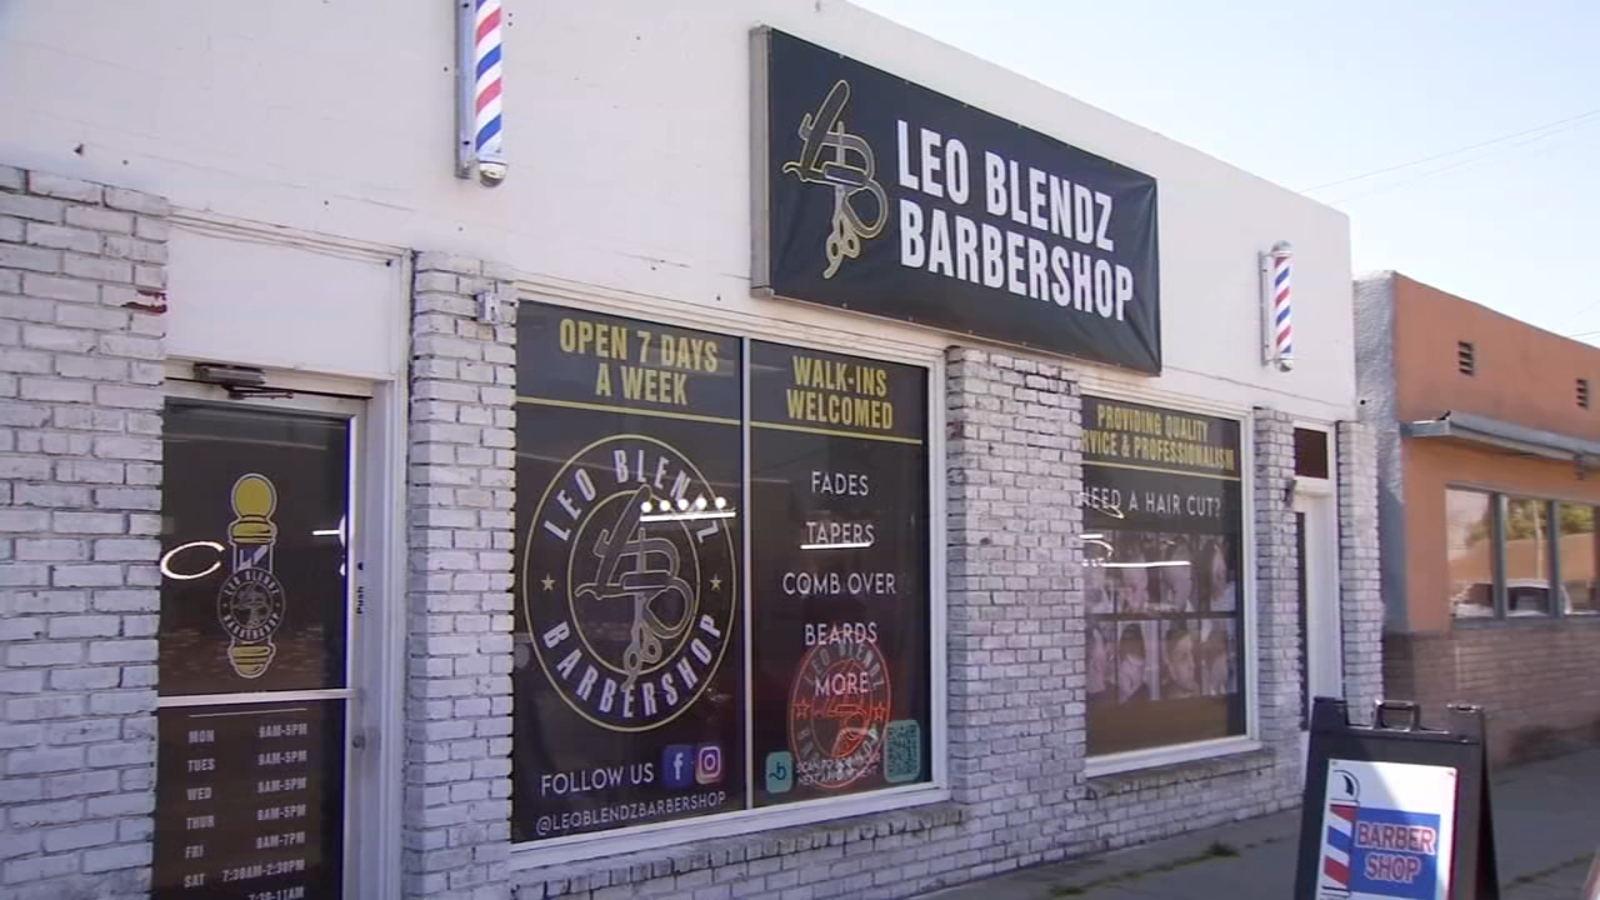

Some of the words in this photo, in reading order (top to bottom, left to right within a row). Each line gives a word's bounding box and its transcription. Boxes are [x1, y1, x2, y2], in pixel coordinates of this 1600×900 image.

[897, 119, 969, 205] LEO
[985, 151, 1114, 252] BLENDZ
[900, 199, 1133, 321] BARBERSHOP
[559, 318, 628, 361] OPEN
[637, 331, 652, 362] 7
[661, 334, 719, 372] DAYS
[595, 364, 611, 397] A
[621, 370, 688, 406] WEEK
[793, 355, 888, 398] WALK-INS
[786, 389, 893, 430] WELCOMED
[1097, 404, 1162, 435] PROVIDING
[1165, 415, 1208, 442] QUALITY
[1080, 429, 1117, 456] RVICE
[1121, 434, 1130, 457] &
[1134, 436, 1235, 471] PROFESSIONALISM
[544, 468, 597, 541] LEO
[613, 450, 719, 543] BLENZ
[811, 471, 869, 496] FADES
[1129, 490, 1139, 511] A
[1145, 492, 1180, 515] HAIR
[1186, 495, 1221, 517] CUT?
[806, 521, 875, 545] TAPERS
[783, 572, 840, 596] COMB
[848, 571, 896, 595] OVER
[805, 622, 877, 646] BEARDS
[543, 613, 720, 718] BARBERSHOP
[814, 672, 869, 696] MORE
[188, 730, 214, 743] MON
[187, 758, 215, 772] TUES
[541, 771, 623, 796] FOLLOW
[629, 762, 655, 784] US
[187, 787, 212, 801] WED
[186, 815, 215, 830] THUR
[536, 791, 726, 836] @LEOBLENDZBARBERSHOP
[185, 844, 204, 859] FRI
[1356, 821, 1436, 855] BARBER
[184, 872, 206, 888] SAT
[1365, 854, 1421, 882] SHOP
